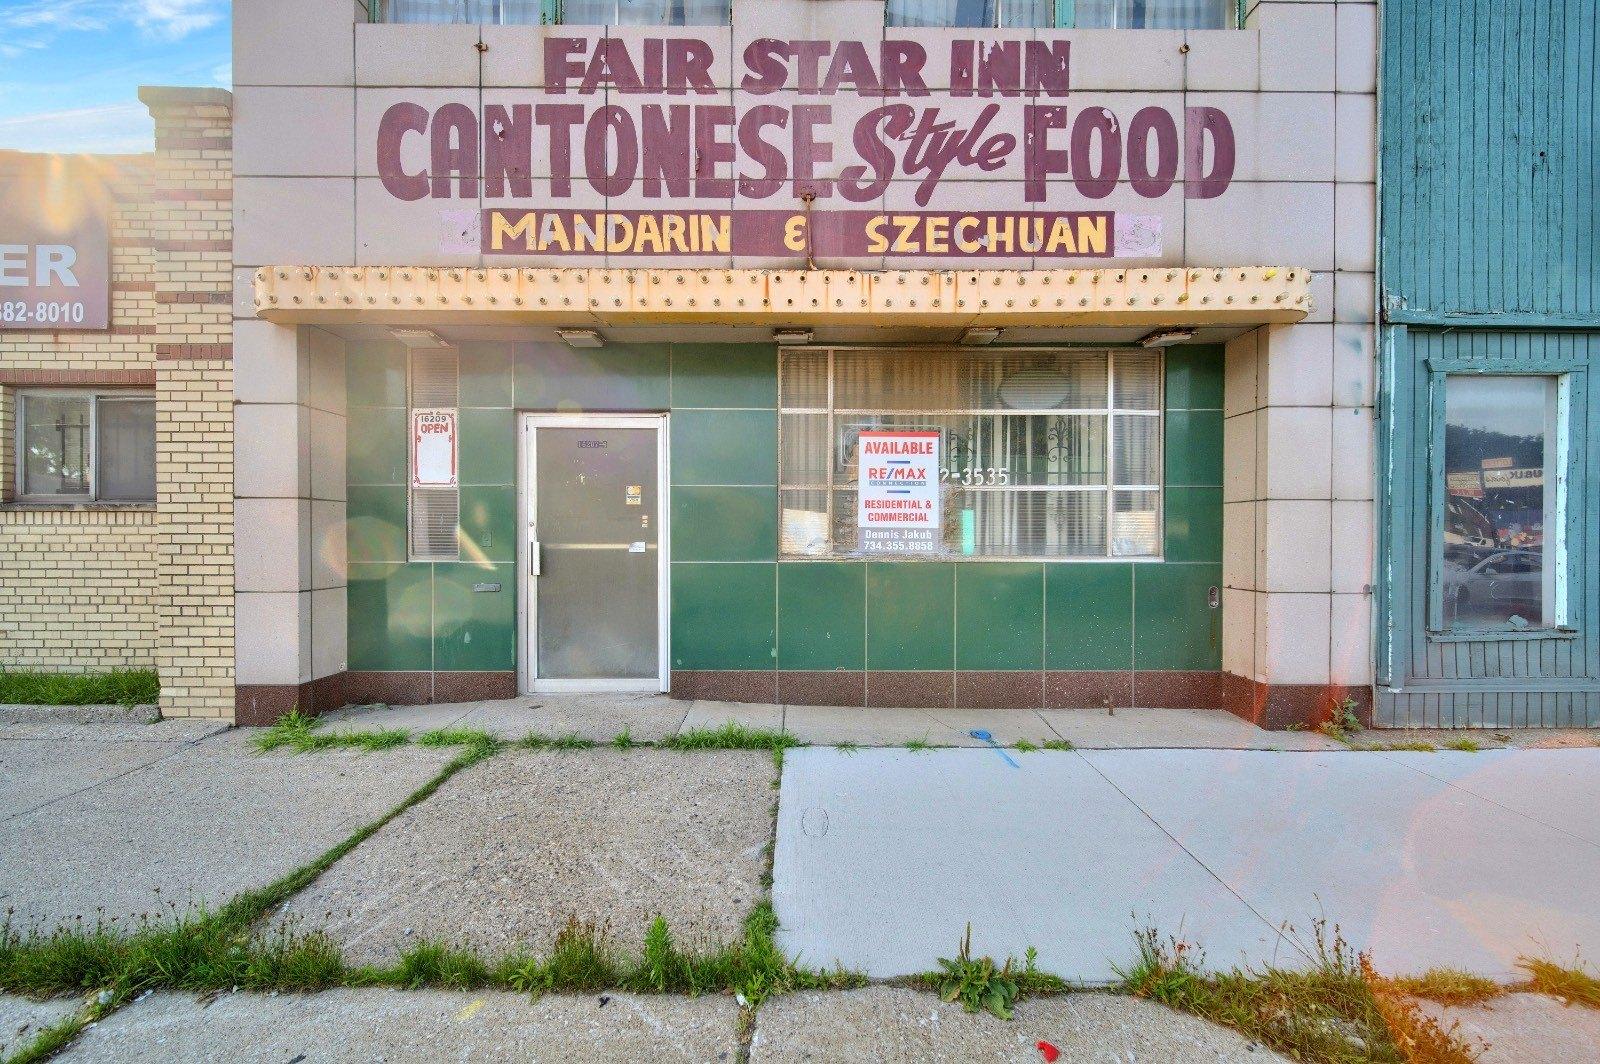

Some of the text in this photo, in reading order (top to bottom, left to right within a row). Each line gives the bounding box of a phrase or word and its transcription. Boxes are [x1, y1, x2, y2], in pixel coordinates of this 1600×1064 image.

[543, 37, 1070, 97] FAIR STAR INN
[376, 102, 1236, 207] CANTONESE Style FOOD
[490, 211, 731, 253] MANDARIN
[864, 215, 1108, 254] SZECHUAN
[0, 301, 84, 323] 82-8010
[421, 415, 447, 423] 16209
[420, 423, 448, 434] OPEN
[864, 441, 934, 455] AVAILABLE
[868, 467, 927, 480] RE/MAX
[864, 499, 932, 509] RESIDENTIAL &
[867, 512, 929, 522] COMMERCIAL
[865, 529, 932, 539] Dennis Jakub
